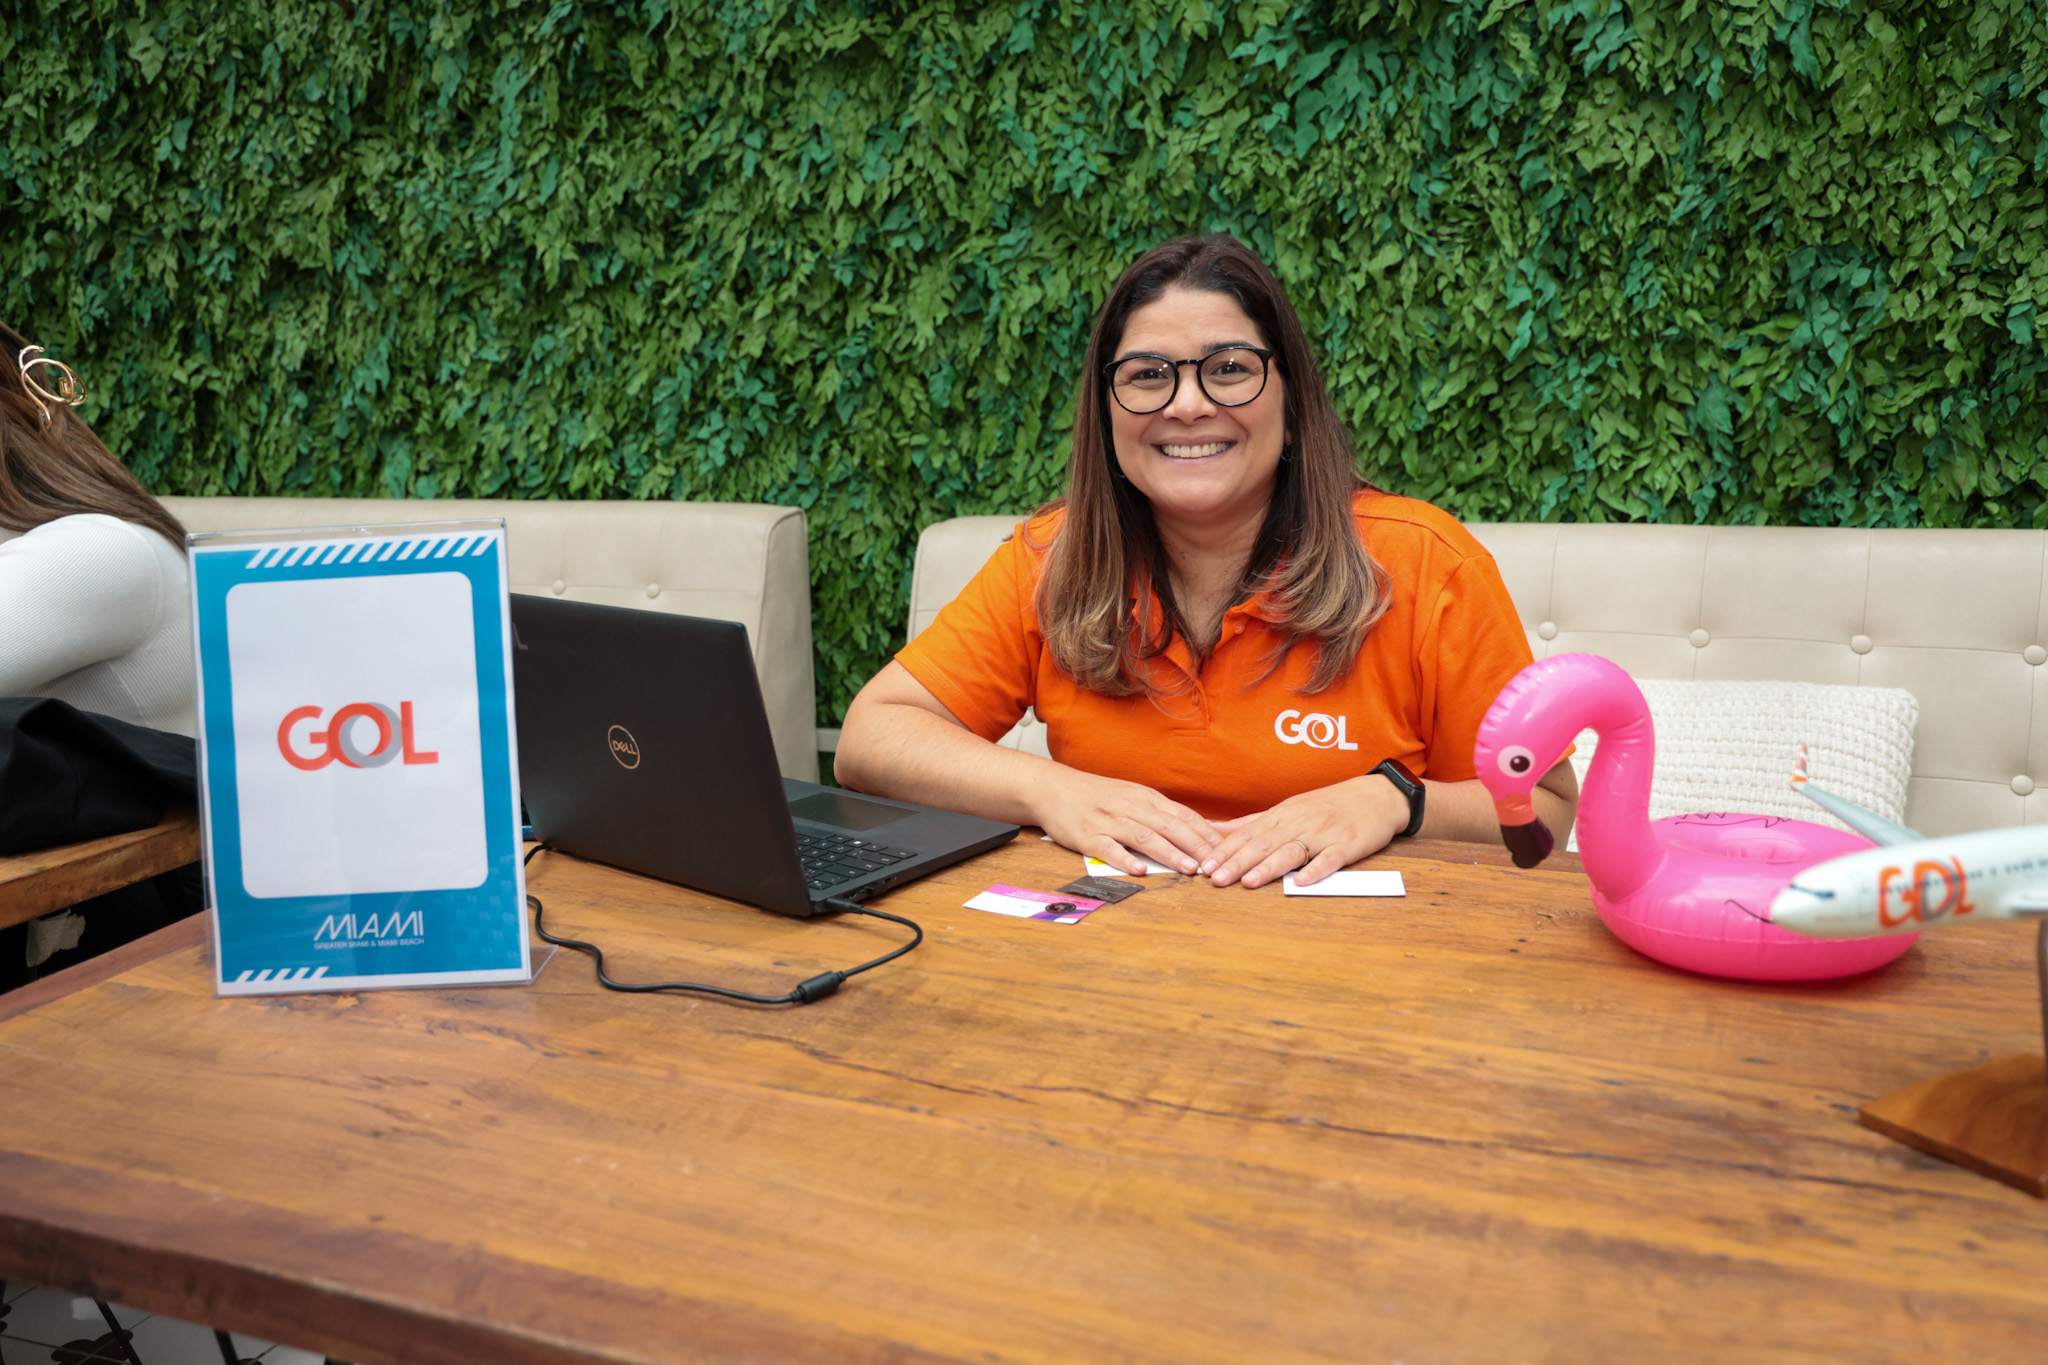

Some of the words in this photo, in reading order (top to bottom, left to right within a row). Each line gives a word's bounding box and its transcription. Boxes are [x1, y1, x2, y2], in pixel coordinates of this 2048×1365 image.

[277, 701, 439, 771] GOL
[612, 740, 637, 755] DELL
[1274, 709, 1358, 750] GOL
[1878, 856, 1976, 928] GOL
[313, 910, 424, 941] MIAMI
[314, 941, 347, 950] GREATER
[349, 940, 369, 948] MIAMI
[378, 939, 398, 947] MIAMI
[399, 938, 424, 946] BEACH
